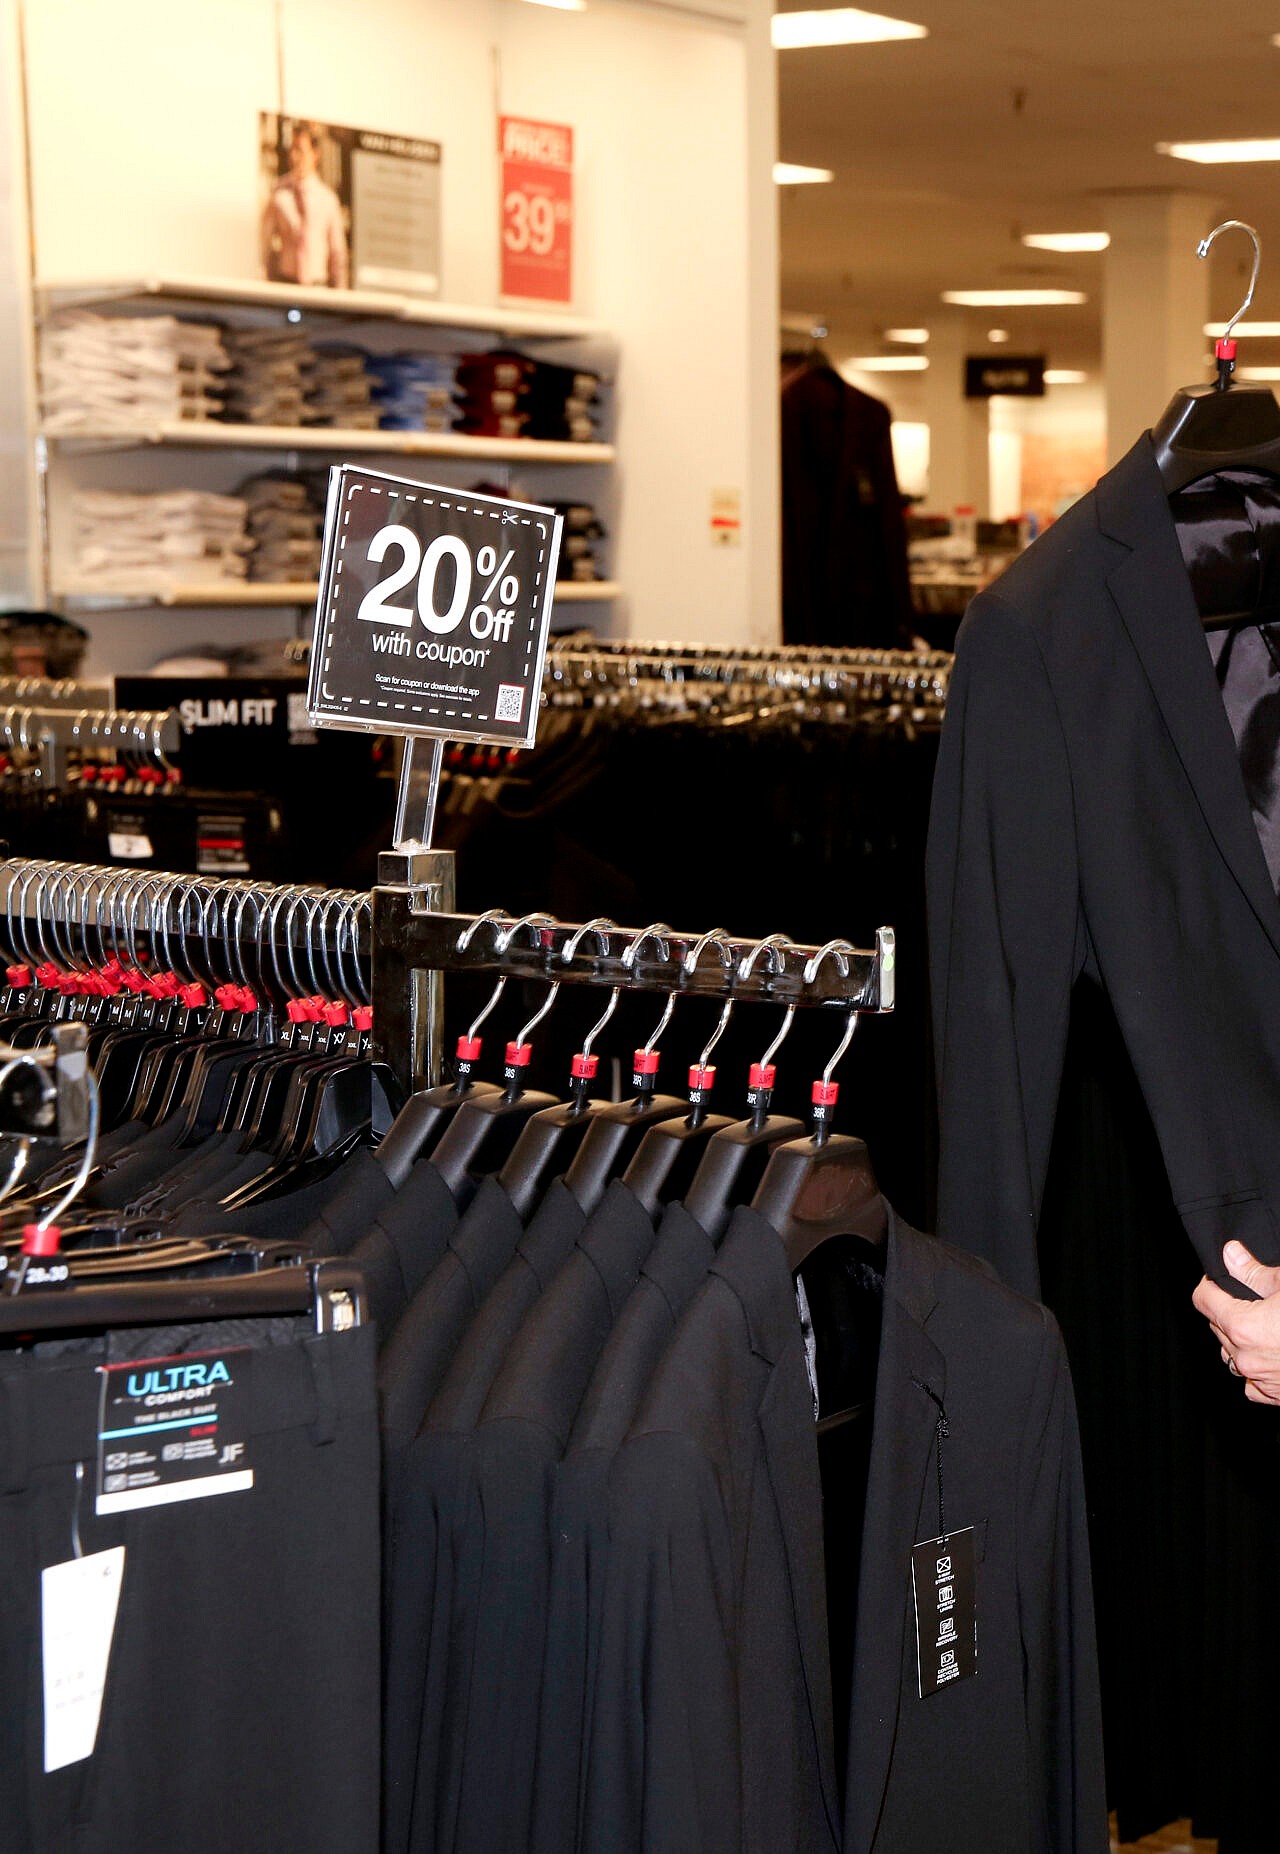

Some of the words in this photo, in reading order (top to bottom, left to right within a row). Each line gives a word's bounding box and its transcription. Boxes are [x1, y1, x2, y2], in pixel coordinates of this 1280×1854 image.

[504, 191, 554, 255] 39
[357, 524, 519, 635] 20%
[469, 604, 515, 643] Off
[372, 632, 410, 657] with
[375, 673, 391, 683] Scan
[391, 676, 400, 685] for
[400, 679, 423, 688] coupon
[430, 682, 458, 693] download
[458, 685, 468, 694] the
[468, 688, 480, 697] app
[180, 699, 238, 727] SLIM
[242, 699, 278, 726] FIT
[127, 1360, 230, 1396] ULTRA
[144, 1384, 215, 1407] COMFORT
[218, 1442, 244, 1464] JF
